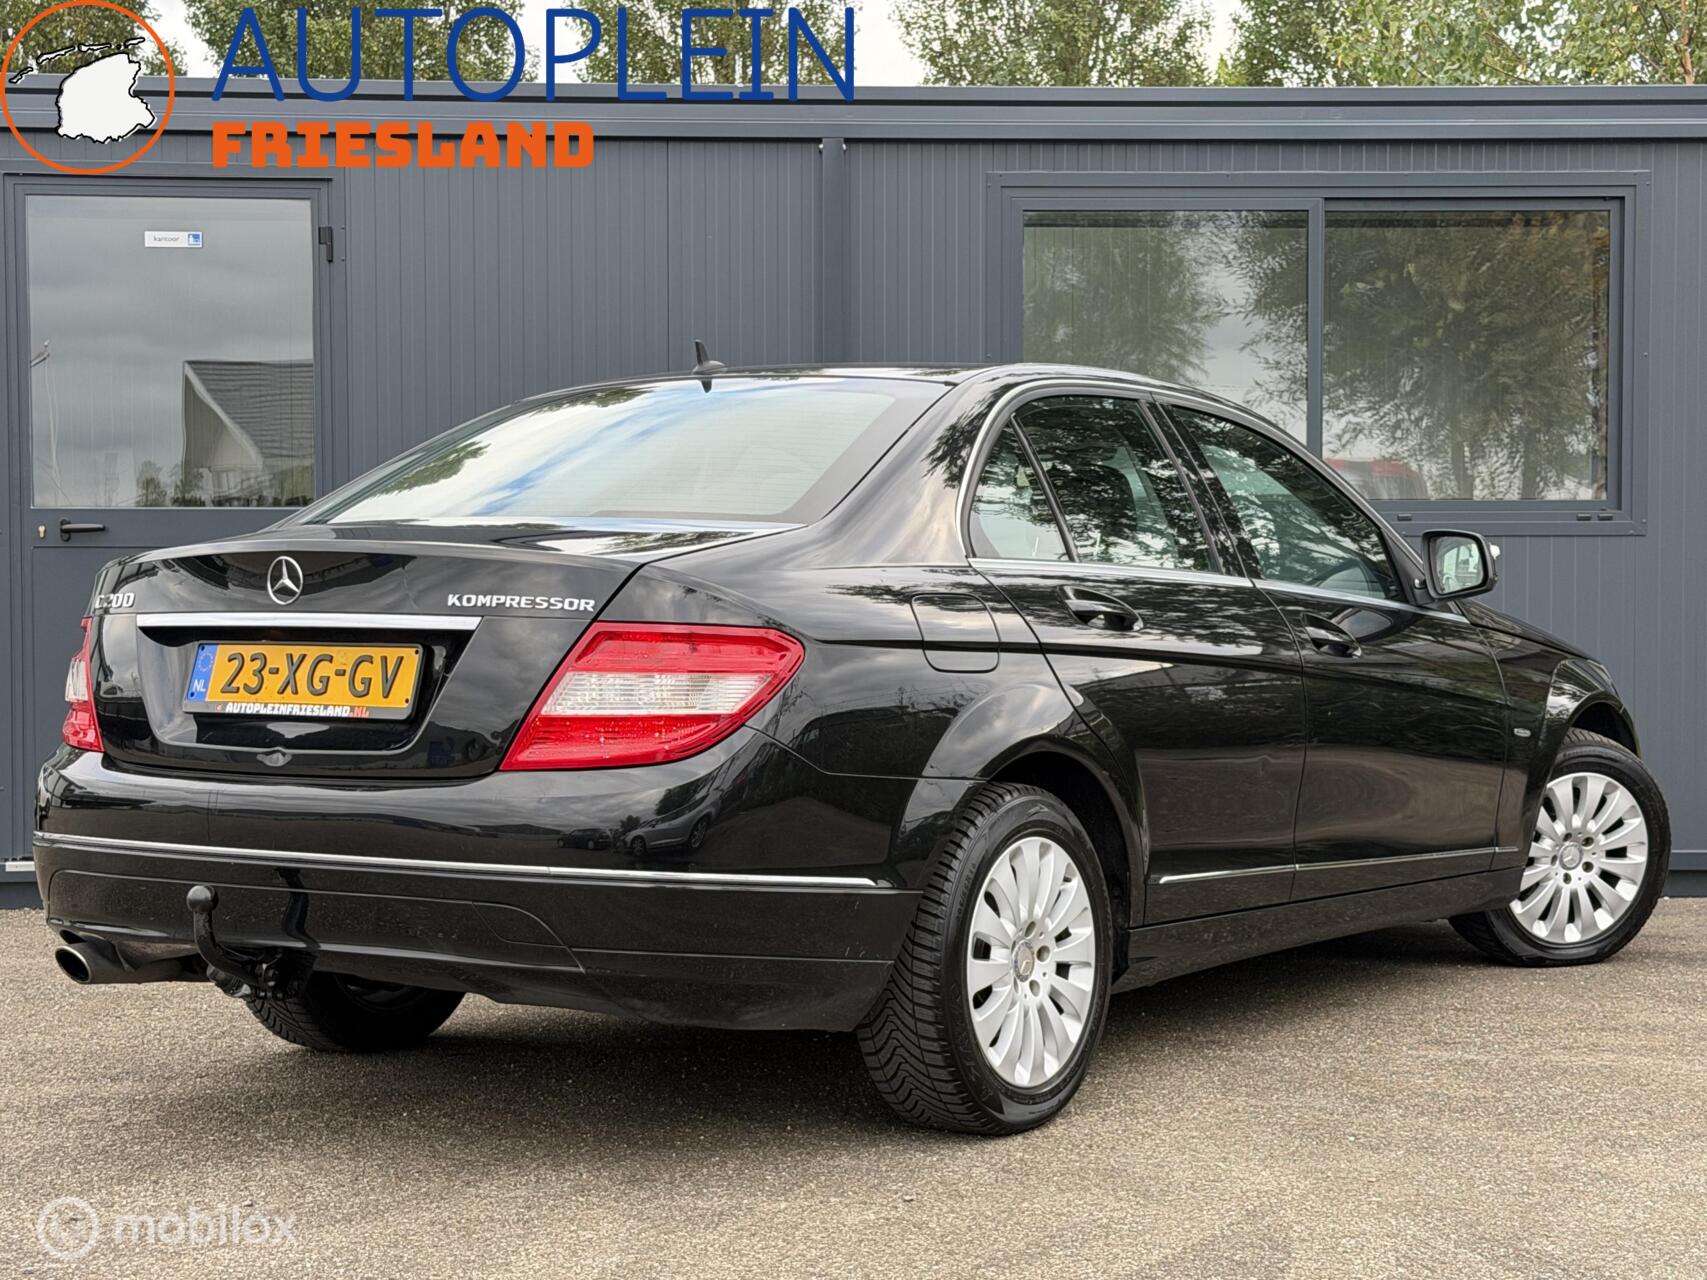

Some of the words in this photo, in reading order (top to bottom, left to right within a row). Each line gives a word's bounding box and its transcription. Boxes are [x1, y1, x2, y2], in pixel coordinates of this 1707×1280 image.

[447, 593, 595, 611] KOMPRESSOR
[220, 652, 404, 698] 23-XG-GV
[192, 679, 206, 692] NL
[226, 702, 369, 718] AUTOPLEINFRIESLAND.NL
